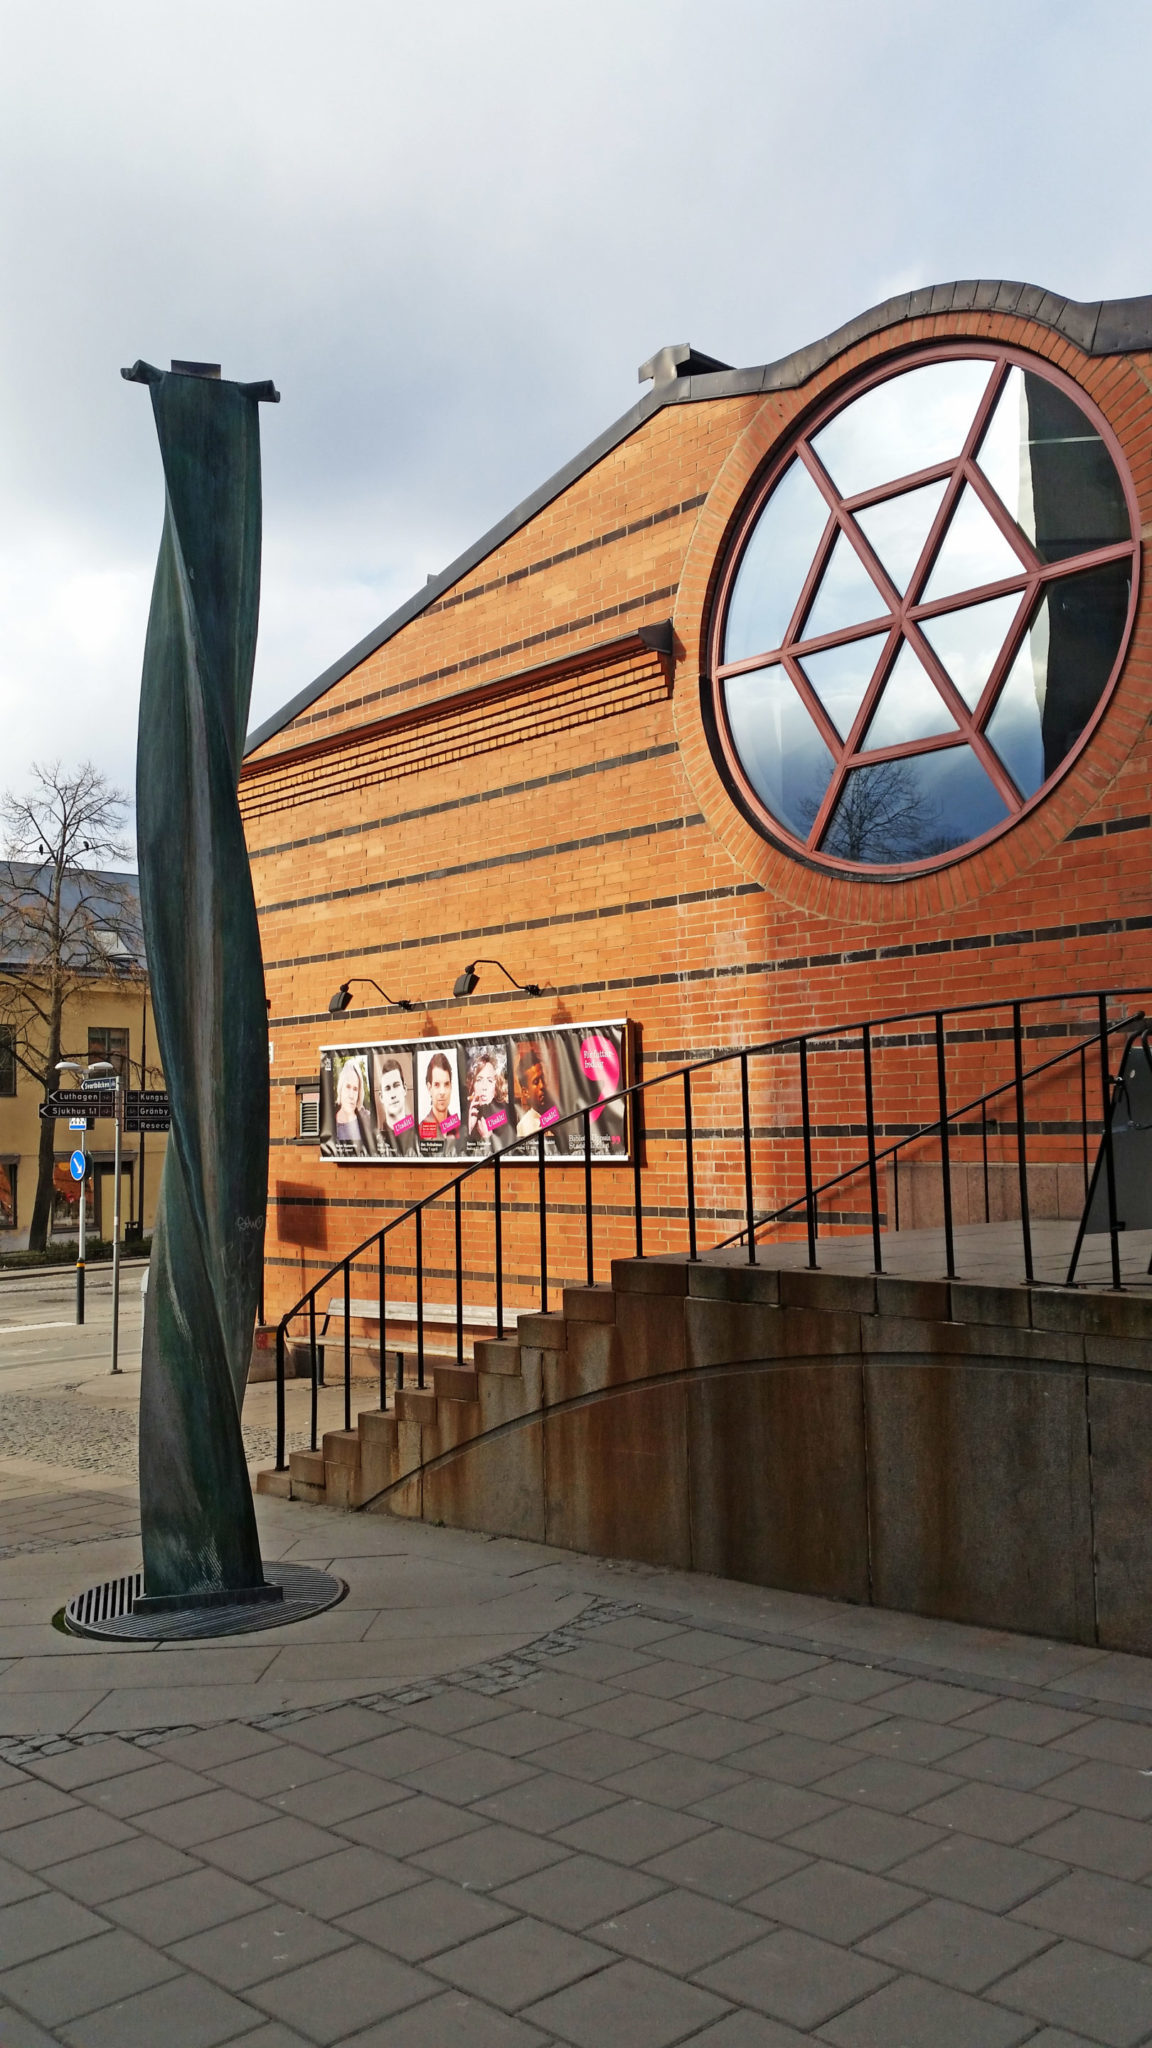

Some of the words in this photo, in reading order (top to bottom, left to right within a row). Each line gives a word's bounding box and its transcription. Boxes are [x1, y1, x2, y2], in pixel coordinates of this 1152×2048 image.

[59, 1092, 98, 1102] Luthagen
[140, 1093, 169, 1102] Kungsä
[52, 1107, 86, 1116] Sjukhus
[140, 1107, 169, 1116] Gränby
[140, 1121, 170, 1129] Resece
